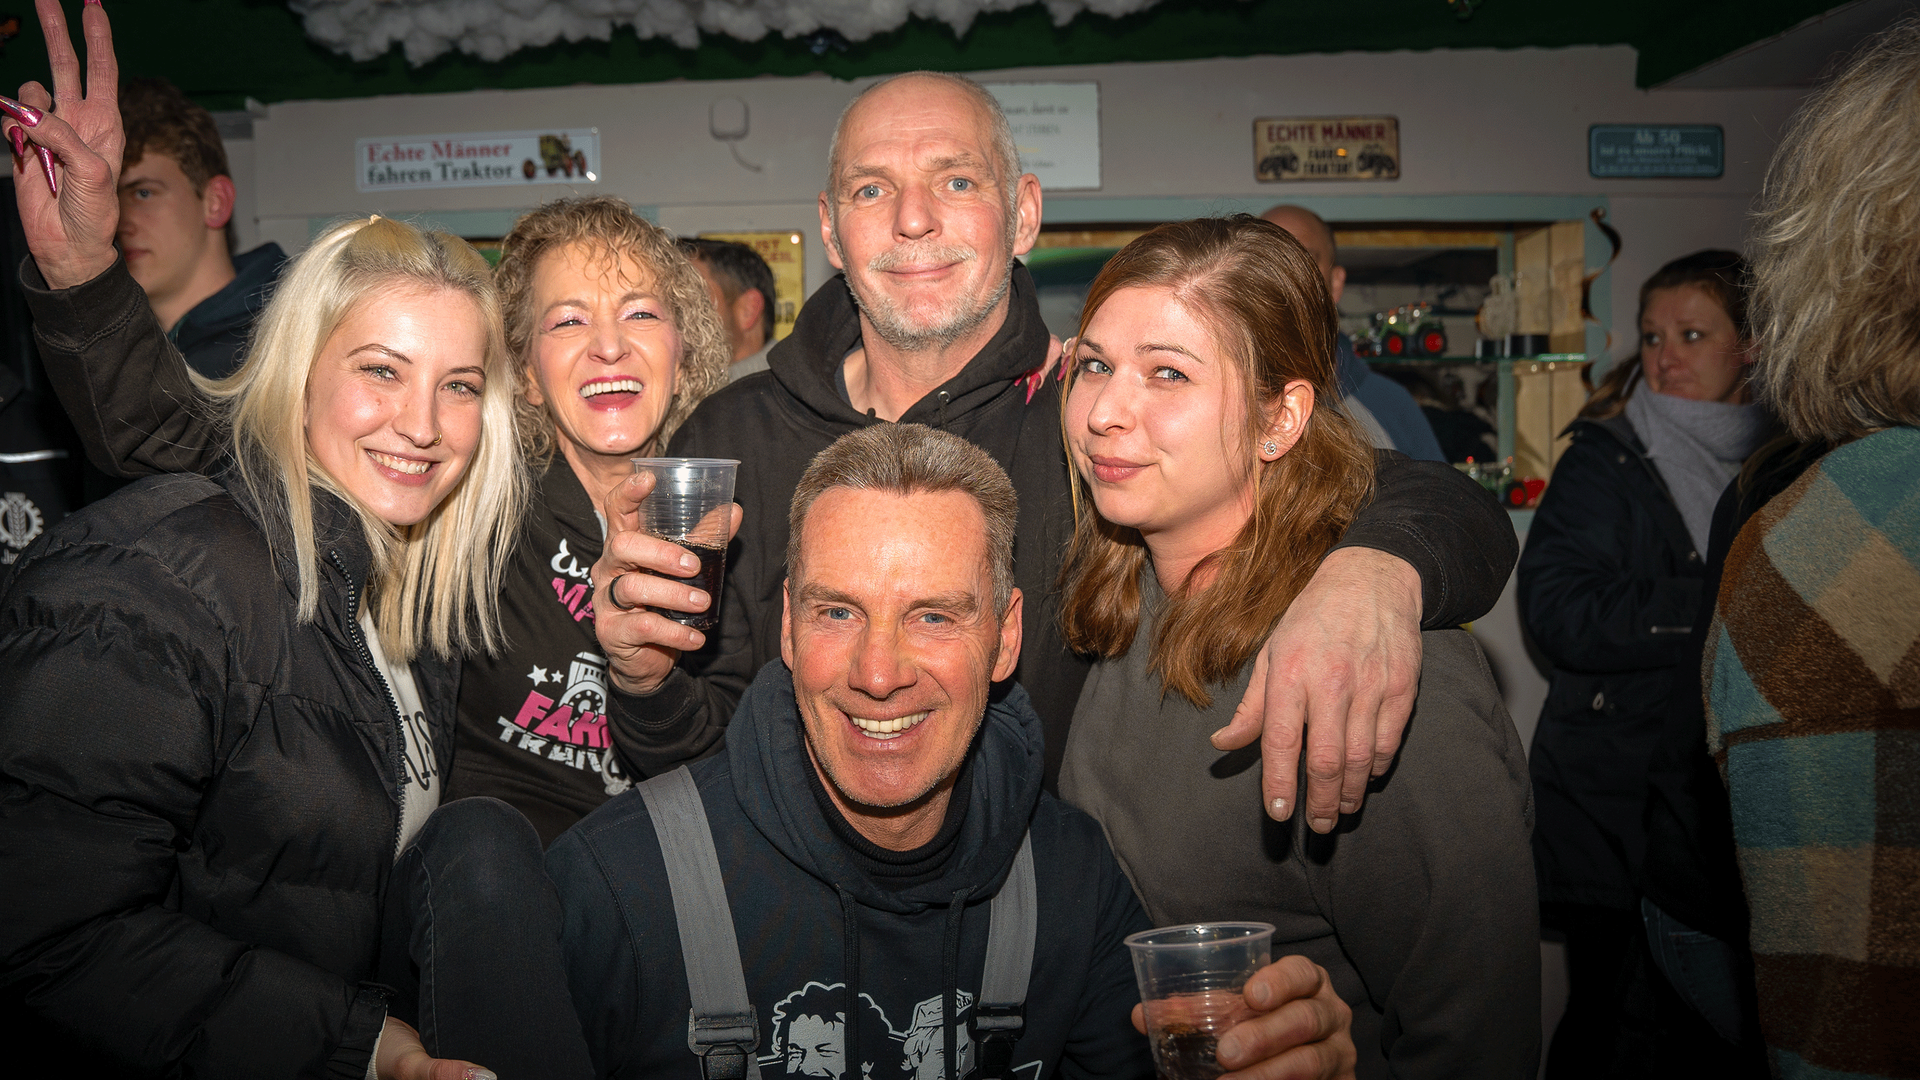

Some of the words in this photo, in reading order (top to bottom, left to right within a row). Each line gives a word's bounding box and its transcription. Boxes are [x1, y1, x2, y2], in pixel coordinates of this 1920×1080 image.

[1267, 124, 1316, 142] ECHTE
[1322, 123, 1385, 141] MÄNNER
[367, 143, 425, 163] Echte
[431, 139, 513, 160] Männer
[367, 164, 432, 185] fahren
[434, 161, 514, 182] Traktor
